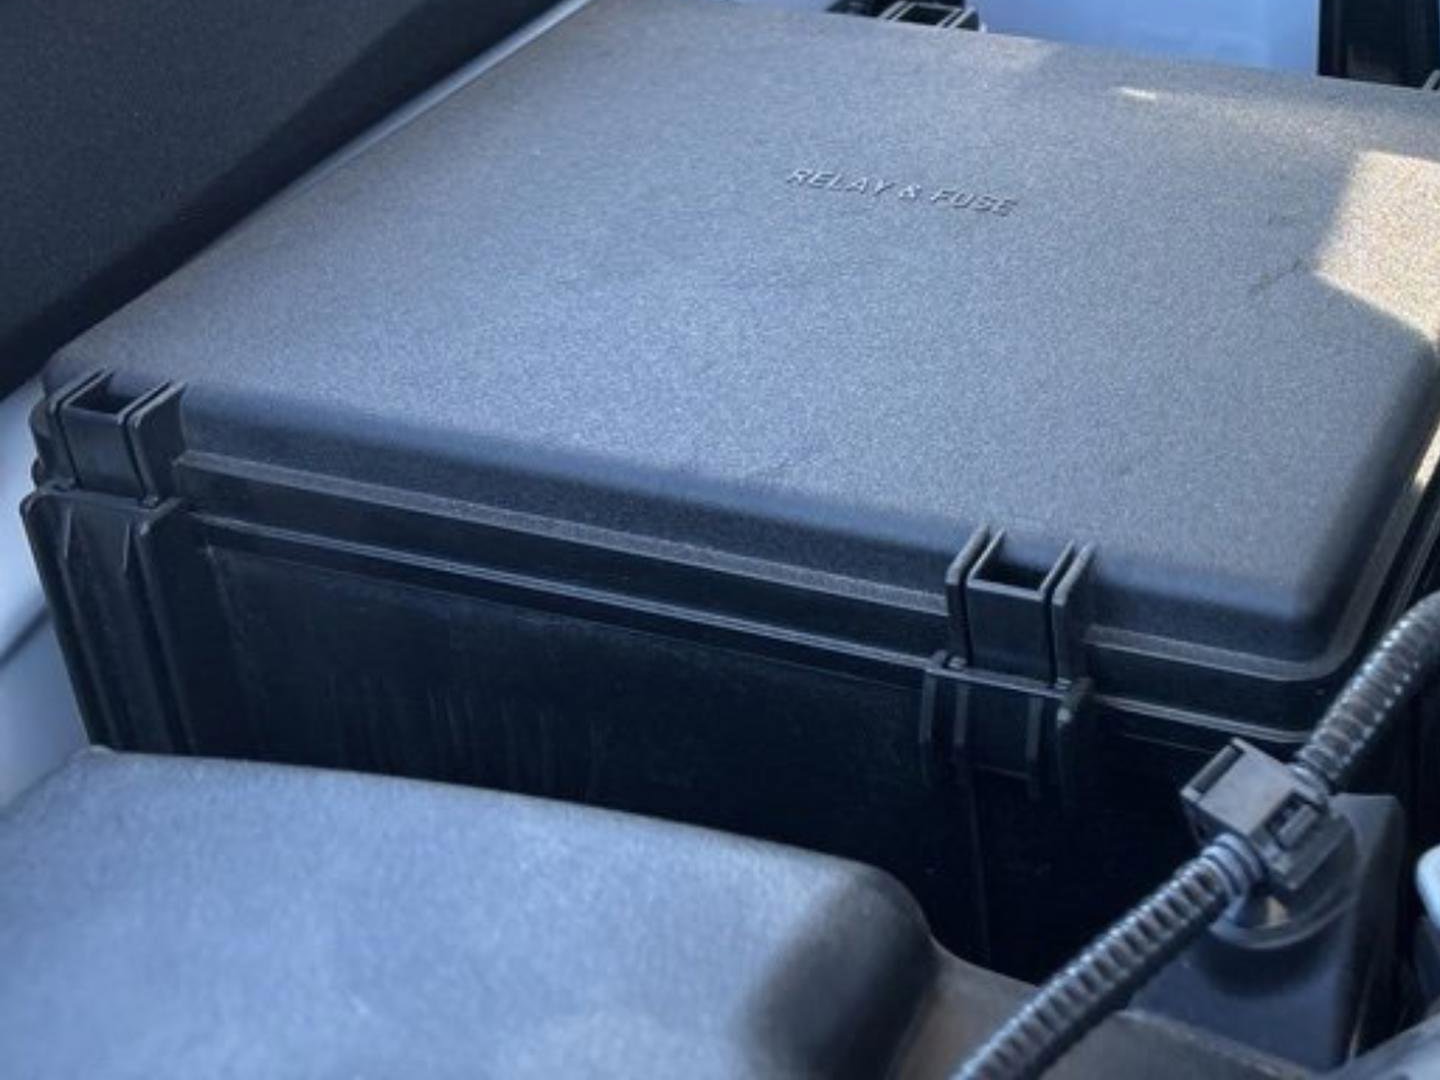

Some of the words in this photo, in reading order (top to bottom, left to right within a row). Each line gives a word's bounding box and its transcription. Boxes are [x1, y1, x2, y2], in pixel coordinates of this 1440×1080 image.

[787, 169, 896, 197] RELAY
[899, 183, 924, 201] &
[930, 187, 1018, 218] FUSE
